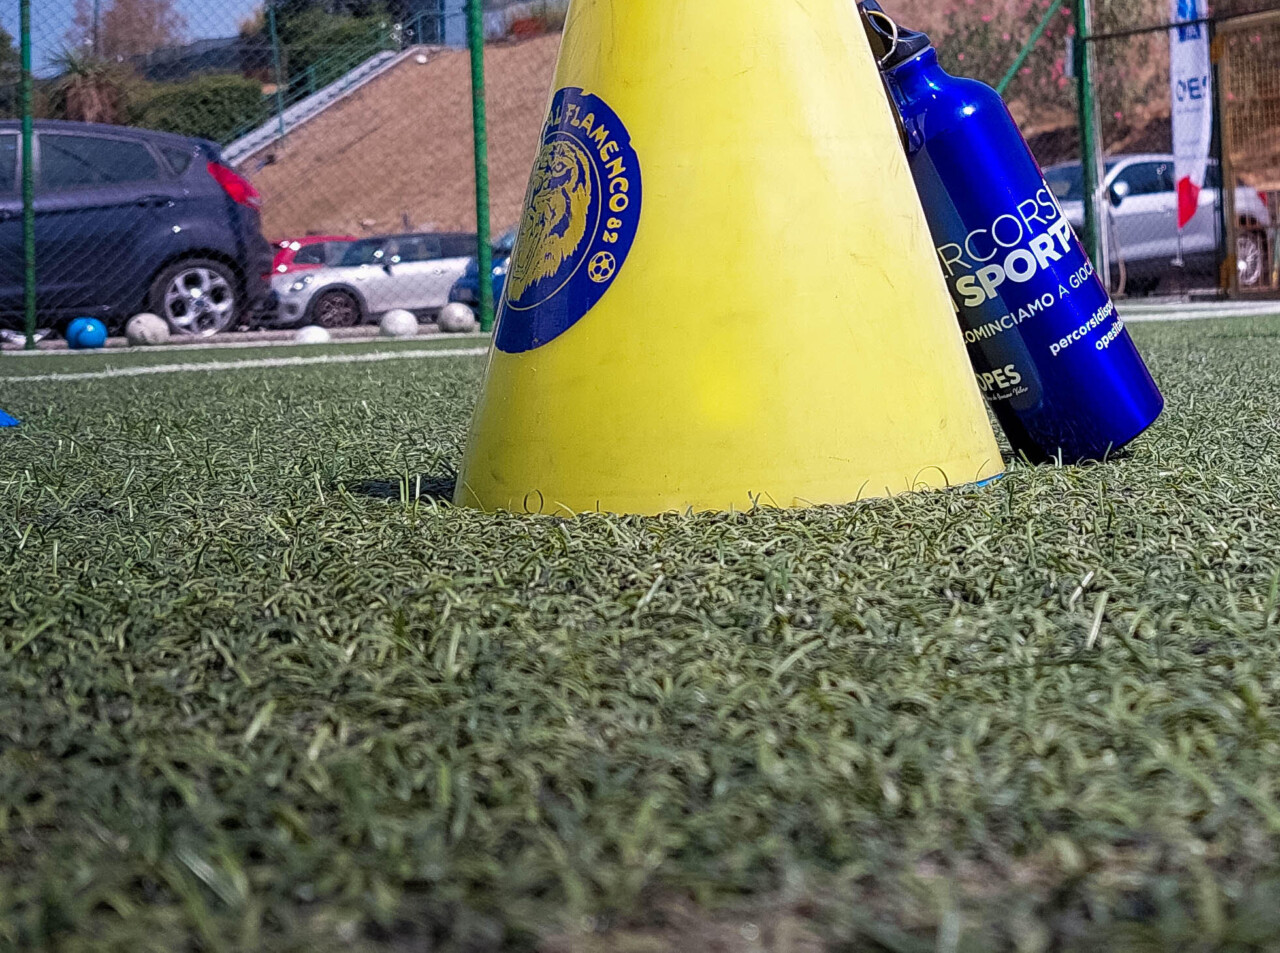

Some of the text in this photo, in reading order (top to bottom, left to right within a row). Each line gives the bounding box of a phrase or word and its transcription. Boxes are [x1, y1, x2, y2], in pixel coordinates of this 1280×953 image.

[565, 103, 629, 212] FLAMENCO
[602, 217, 623, 243] 82
[1058, 284, 1071, 299] A
[1069, 257, 1094, 289] GIOC
